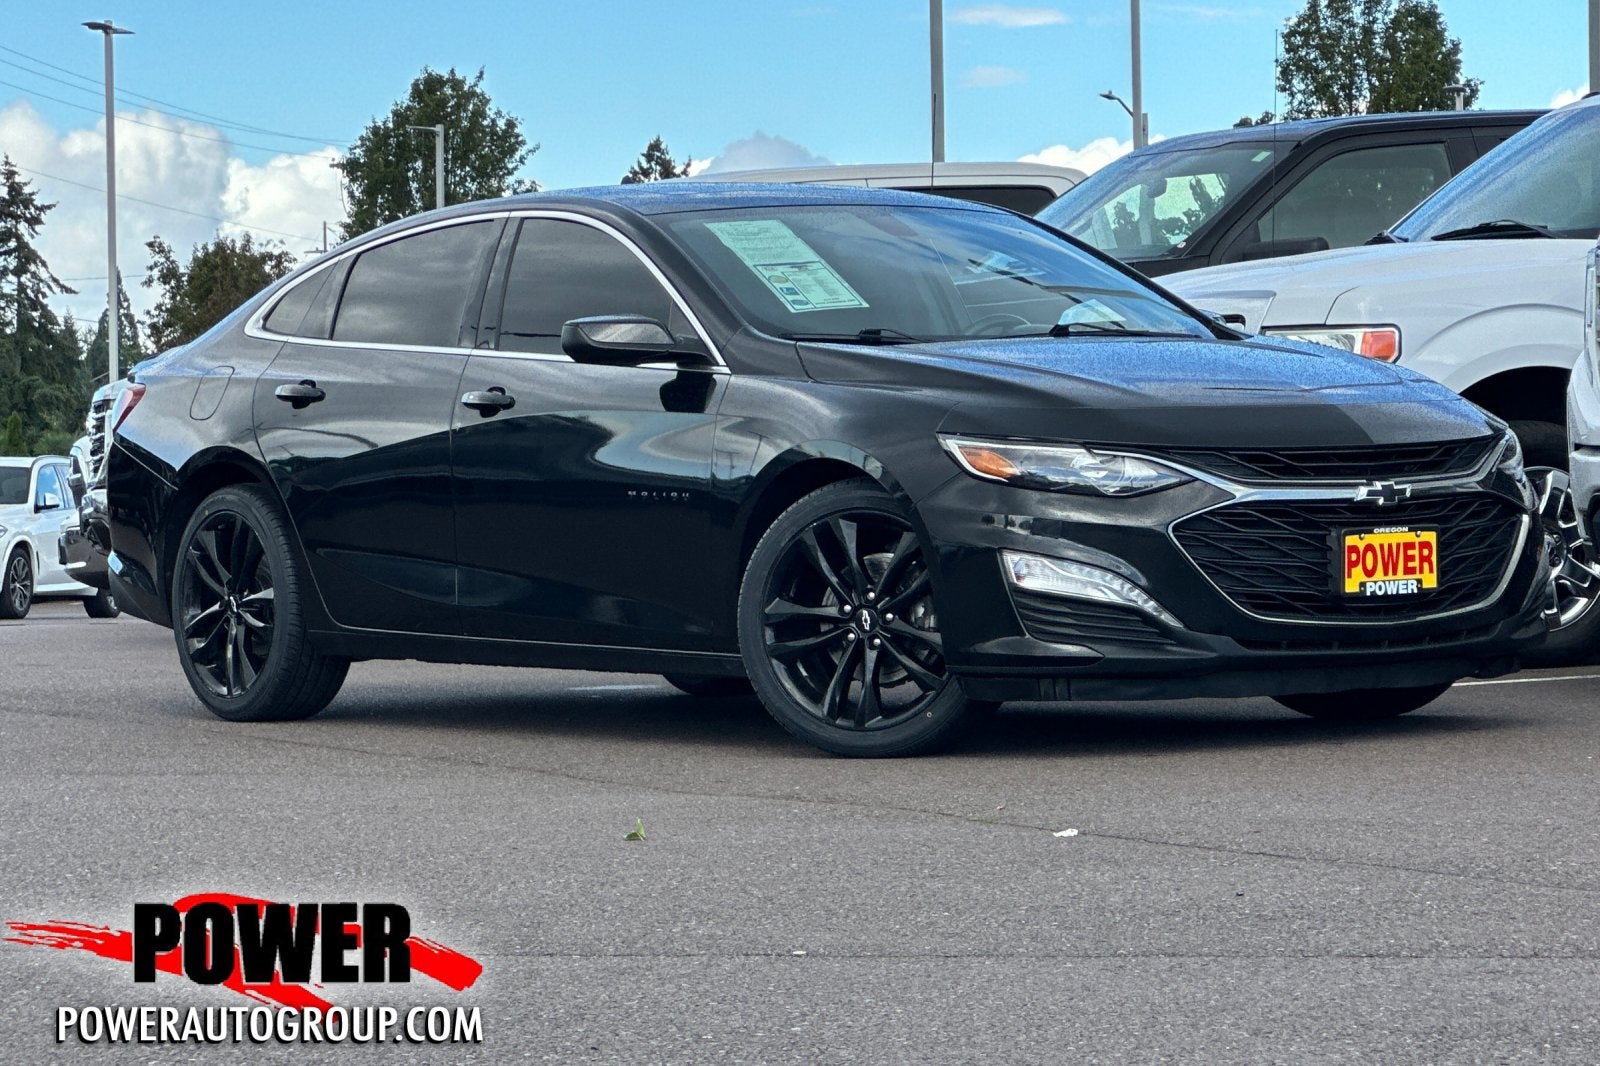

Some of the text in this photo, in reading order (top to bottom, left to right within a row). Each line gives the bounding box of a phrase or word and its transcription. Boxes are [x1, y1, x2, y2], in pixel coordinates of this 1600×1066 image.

[1373, 526, 1409, 534] OREGON
[1346, 541, 1434, 579] POWER
[1365, 580, 1418, 596] POWER
